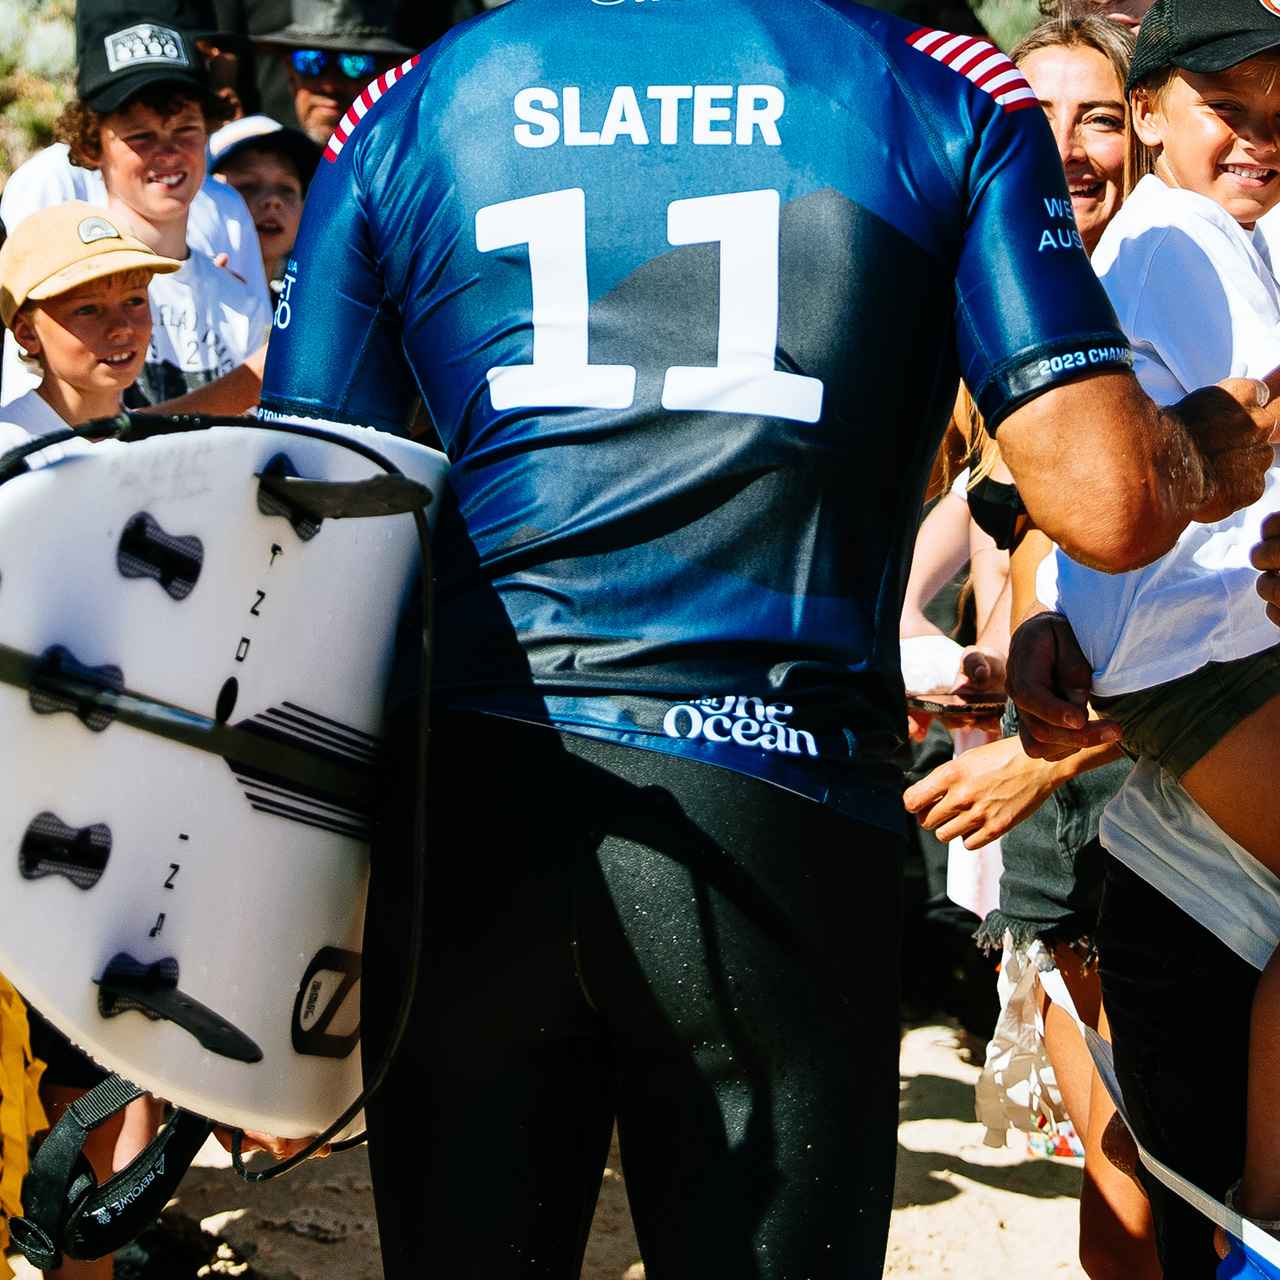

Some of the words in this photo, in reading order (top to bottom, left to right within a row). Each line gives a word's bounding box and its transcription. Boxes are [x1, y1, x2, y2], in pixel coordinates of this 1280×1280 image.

[513, 84, 785, 149] SLATER
[475, 187, 824, 425] 11
[1038, 351, 1087, 377] 2023
[663, 704, 819, 757] Ocean
